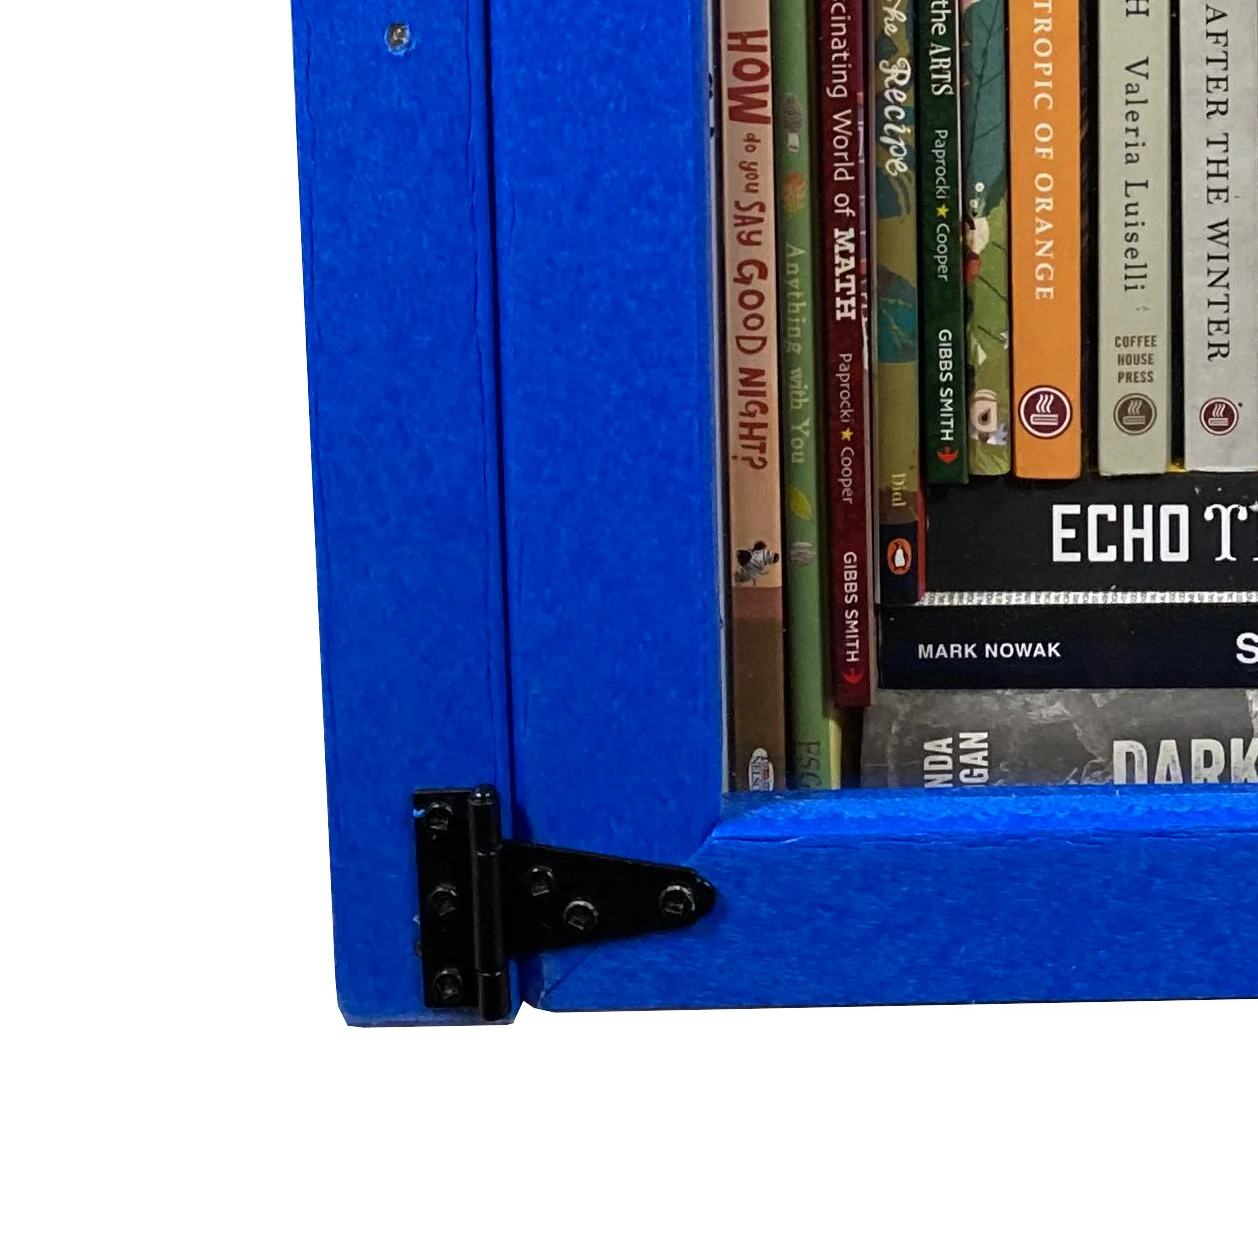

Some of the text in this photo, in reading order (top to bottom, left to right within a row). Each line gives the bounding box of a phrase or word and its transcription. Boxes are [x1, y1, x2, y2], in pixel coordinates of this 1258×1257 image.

[726, 29, 772, 125] HOW
[929, 42, 954, 97] ARTS
[742, 132, 762, 153] do
[831, 109, 855, 181] World
[879, 58, 913, 176] Recipe
[1034, 122, 1053, 160] OF
[738, 160, 760, 194] you
[834, 193, 856, 217] of
[932, 129, 950, 281] Paprocki Cooper
[1123, 56, 1149, 292] Valeria Luiselli
[1205, 4, 1231, 363] AFTER THE WINTER
[1034, 173, 1055, 301] ORANGE
[834, 227, 857, 321] MATH
[785, 243, 811, 464] Anything with You
[1114, 334, 1157, 349] COFFEE
[1117, 353, 1154, 366] HOUSE
[938, 328, 954, 442] GIBBS SMITH
[1117, 370, 1154, 384] PRESS
[731, 366, 768, 471] NIGHT?
[836, 353, 854, 505] Paprocki Cooper
[891, 473, 906, 508] Dial
[1051, 503, 1190, 563] ECHO
[843, 551, 859, 663] GIBBS SMITH
[917, 642, 1061, 659] MARK NOWAK
[923, 736, 953, 789] NDA
[958, 731, 989, 789] GAN
